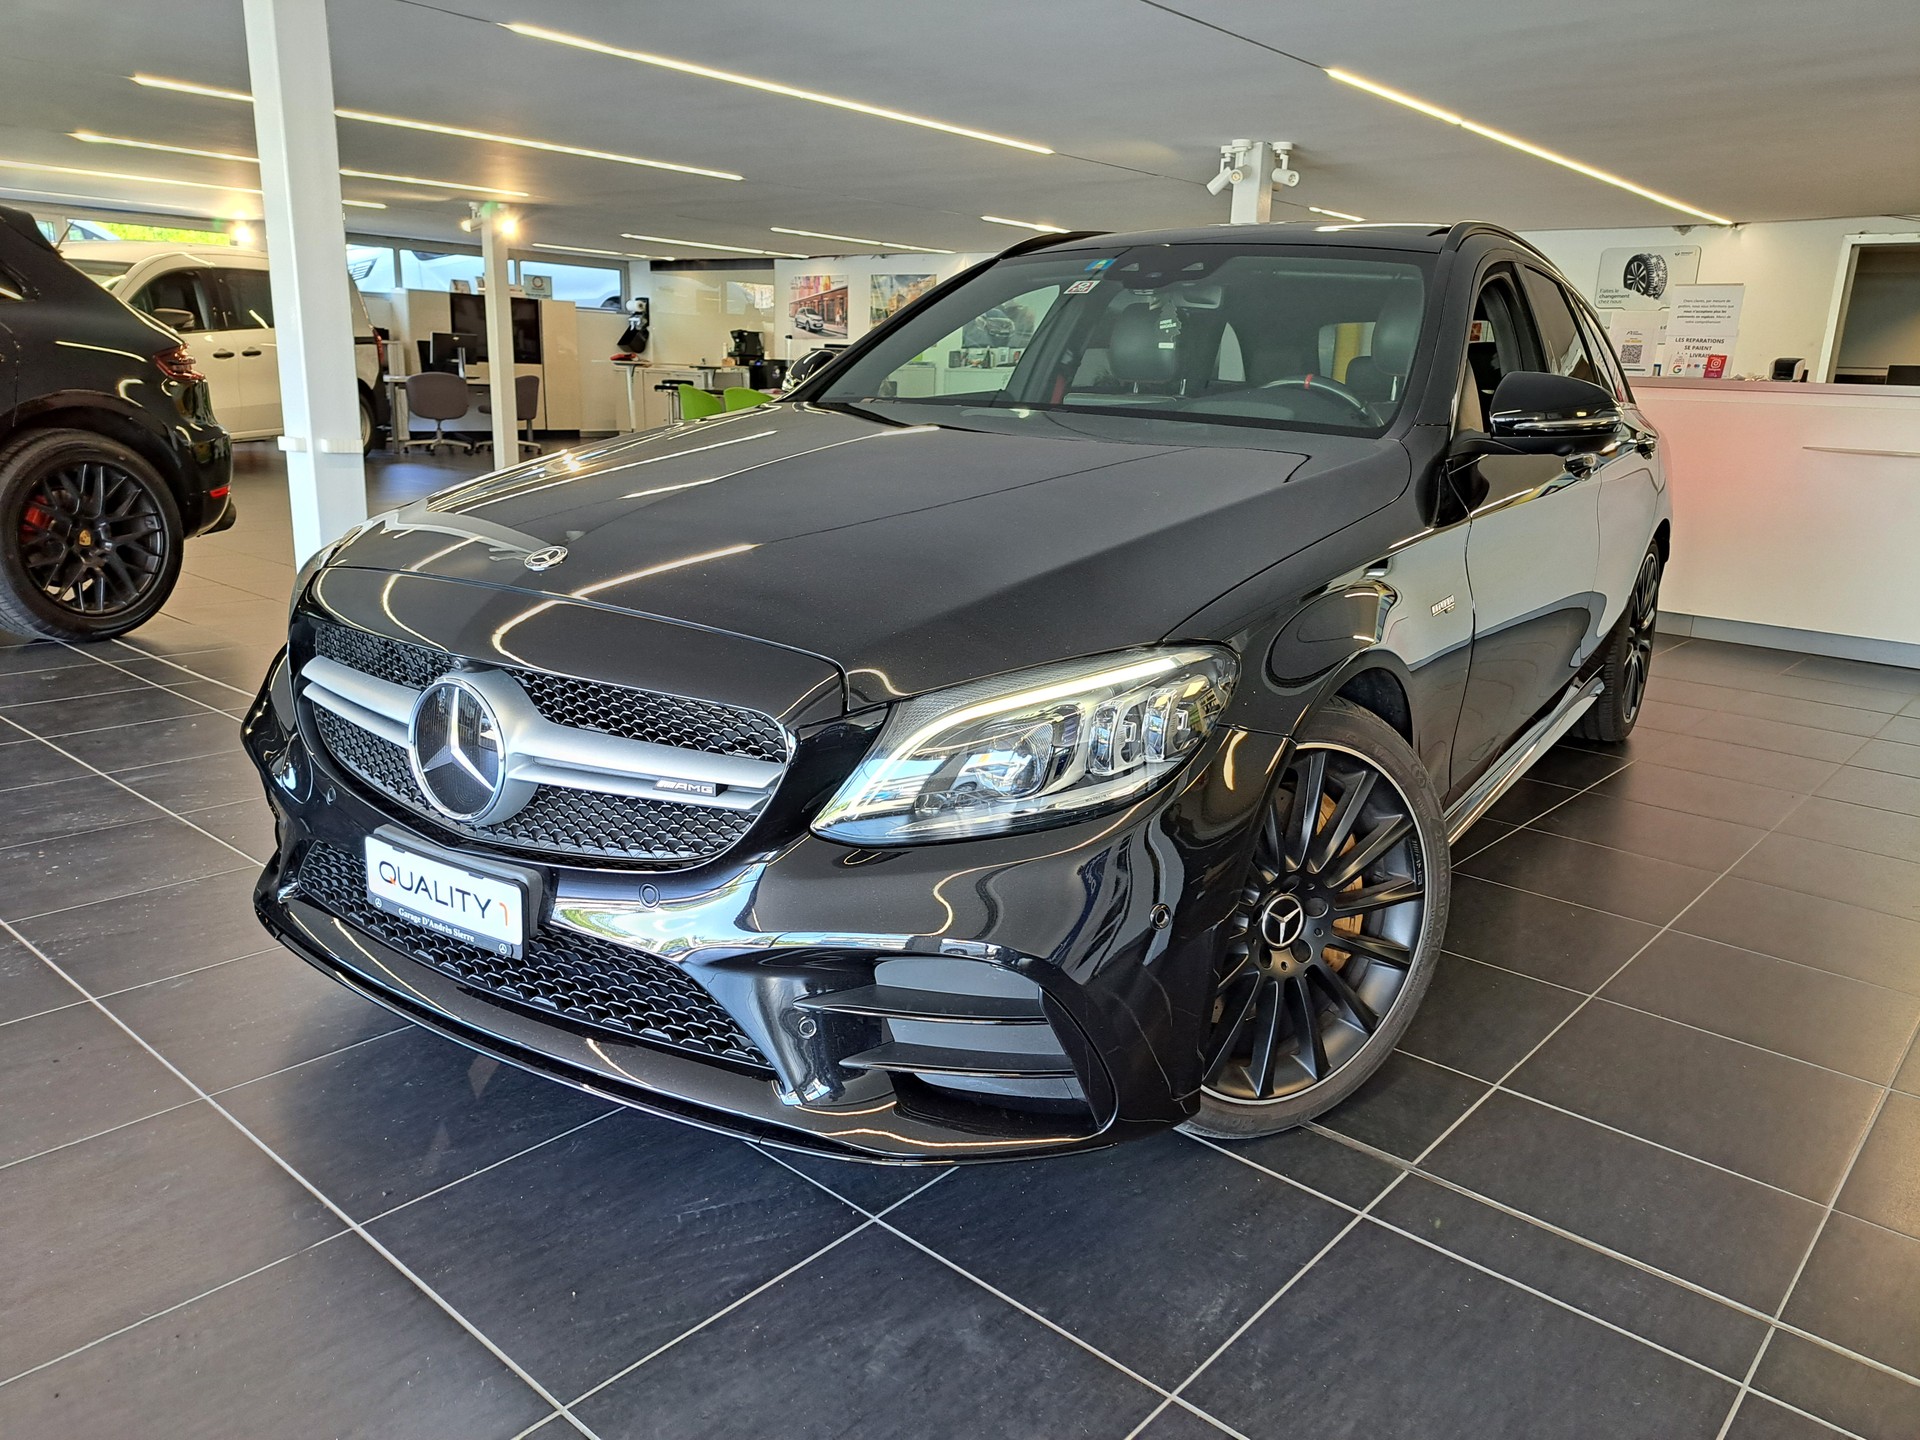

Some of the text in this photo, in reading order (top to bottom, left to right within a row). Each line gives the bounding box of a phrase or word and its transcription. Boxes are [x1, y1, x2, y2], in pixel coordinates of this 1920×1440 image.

[674, 782, 713, 794] AMG
[398, 907, 421, 924] Garage
[453, 927, 475, 942] Sierre
